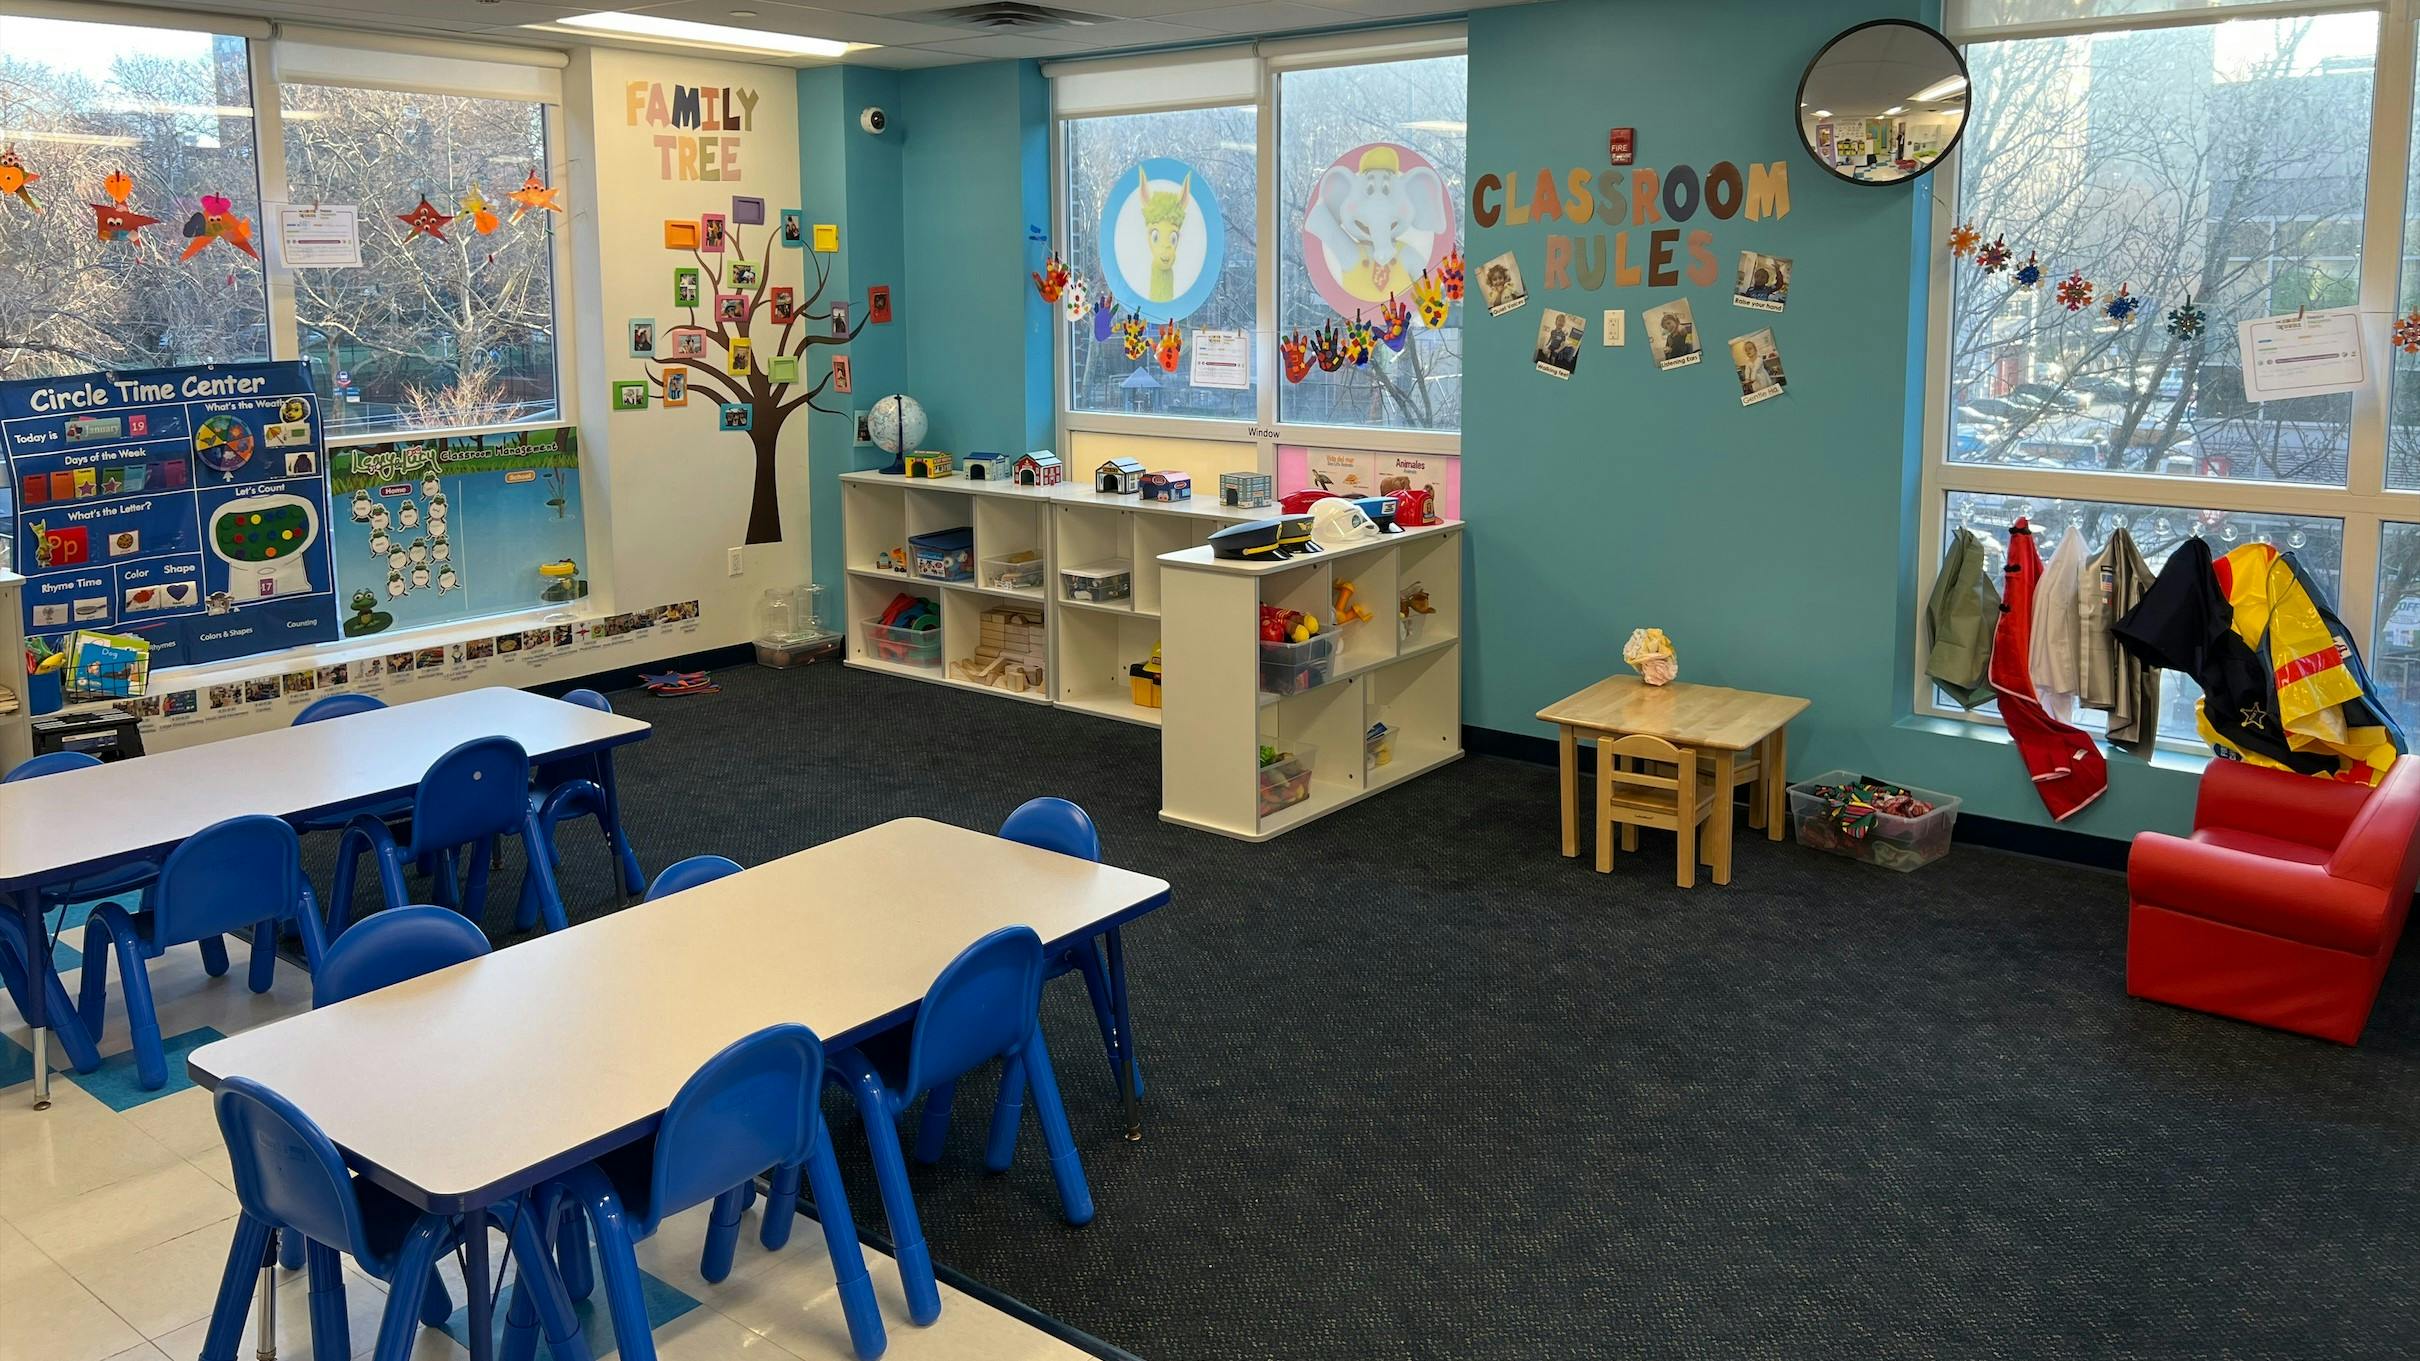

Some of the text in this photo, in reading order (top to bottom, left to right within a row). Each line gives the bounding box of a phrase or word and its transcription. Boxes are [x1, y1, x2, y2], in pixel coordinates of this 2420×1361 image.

[626, 80, 760, 132] FAMILY
[653, 134, 742, 182] TREE
[1472, 160, 1791, 228] CLASSROOM
[1544, 229, 1719, 291] RULES
[1493, 304, 1508, 315] Quiet
[1766, 303, 1782, 311] hand
[1661, 355, 1698, 368] Listening Ears
[1537, 363, 1558, 376] Walking
[29, 374, 266, 412] Circle Time Center
[1743, 391, 1767, 404] Gentle
[205, 398, 287, 412] What's the Weath
[83, 423, 120, 437] January
[131, 421, 145, 432] 19
[1248, 426, 1281, 438] Window
[14, 431, 59, 444] Today is
[64, 447, 147, 466] Days of the Week
[440, 442, 559, 461] Classroom Management
[1396, 458, 1425, 470] Animales
[235, 483, 286, 497] Let's Count
[385, 486, 407, 495] Home
[68, 501, 153, 521] What's the Letter?
[124, 569, 150, 580] Color
[163, 564, 196, 575] Shape
[41, 577, 103, 594] Rhyme Time
[260, 582, 273, 592] 17
[286, 618, 318, 630] Counting
[199, 627, 254, 642] Colors & Shapes
[101, 647, 119, 660] Dog
